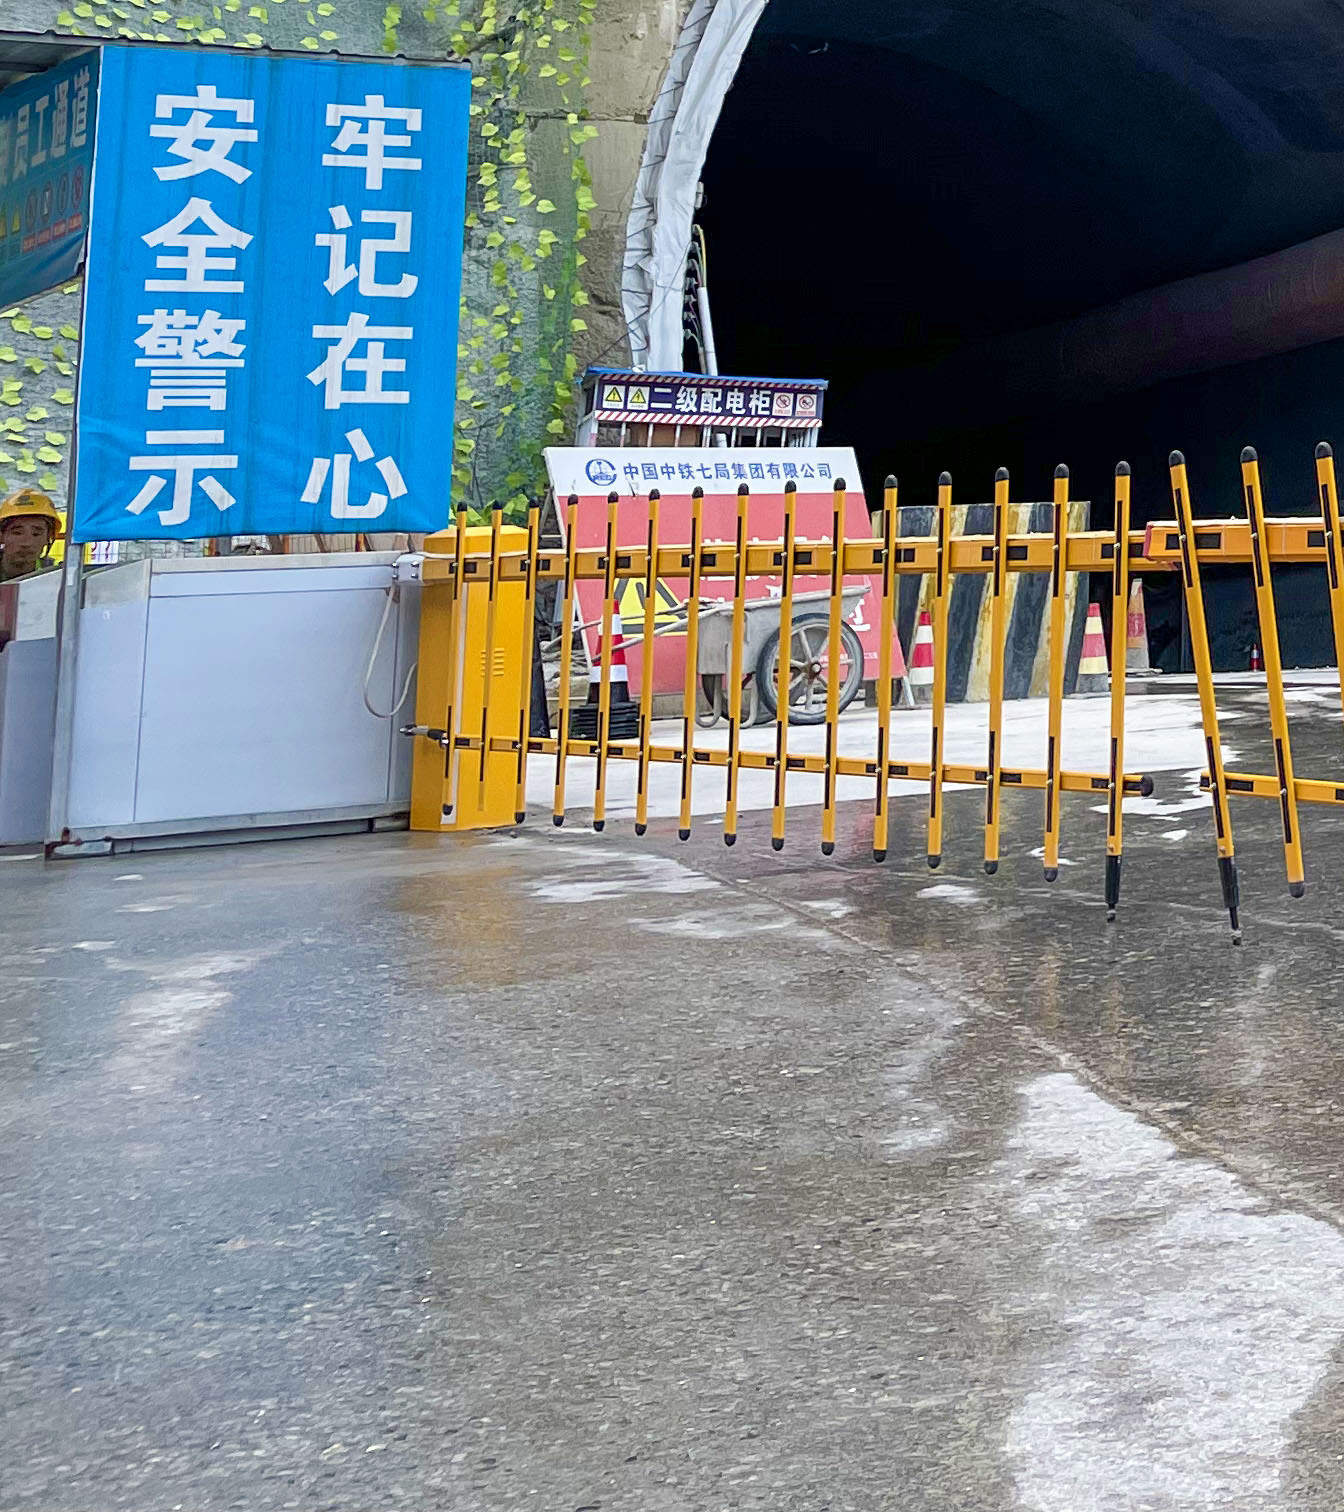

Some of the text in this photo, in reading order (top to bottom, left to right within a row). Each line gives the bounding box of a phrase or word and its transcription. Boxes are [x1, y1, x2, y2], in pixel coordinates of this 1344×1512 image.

[127, 85, 259, 527] 安全警示
[300, 95, 423, 520] 牢记在心
[650, 386, 771, 416] 二级配电柜
[623, 462, 833, 481] 中国中铁七局集团有限公司
